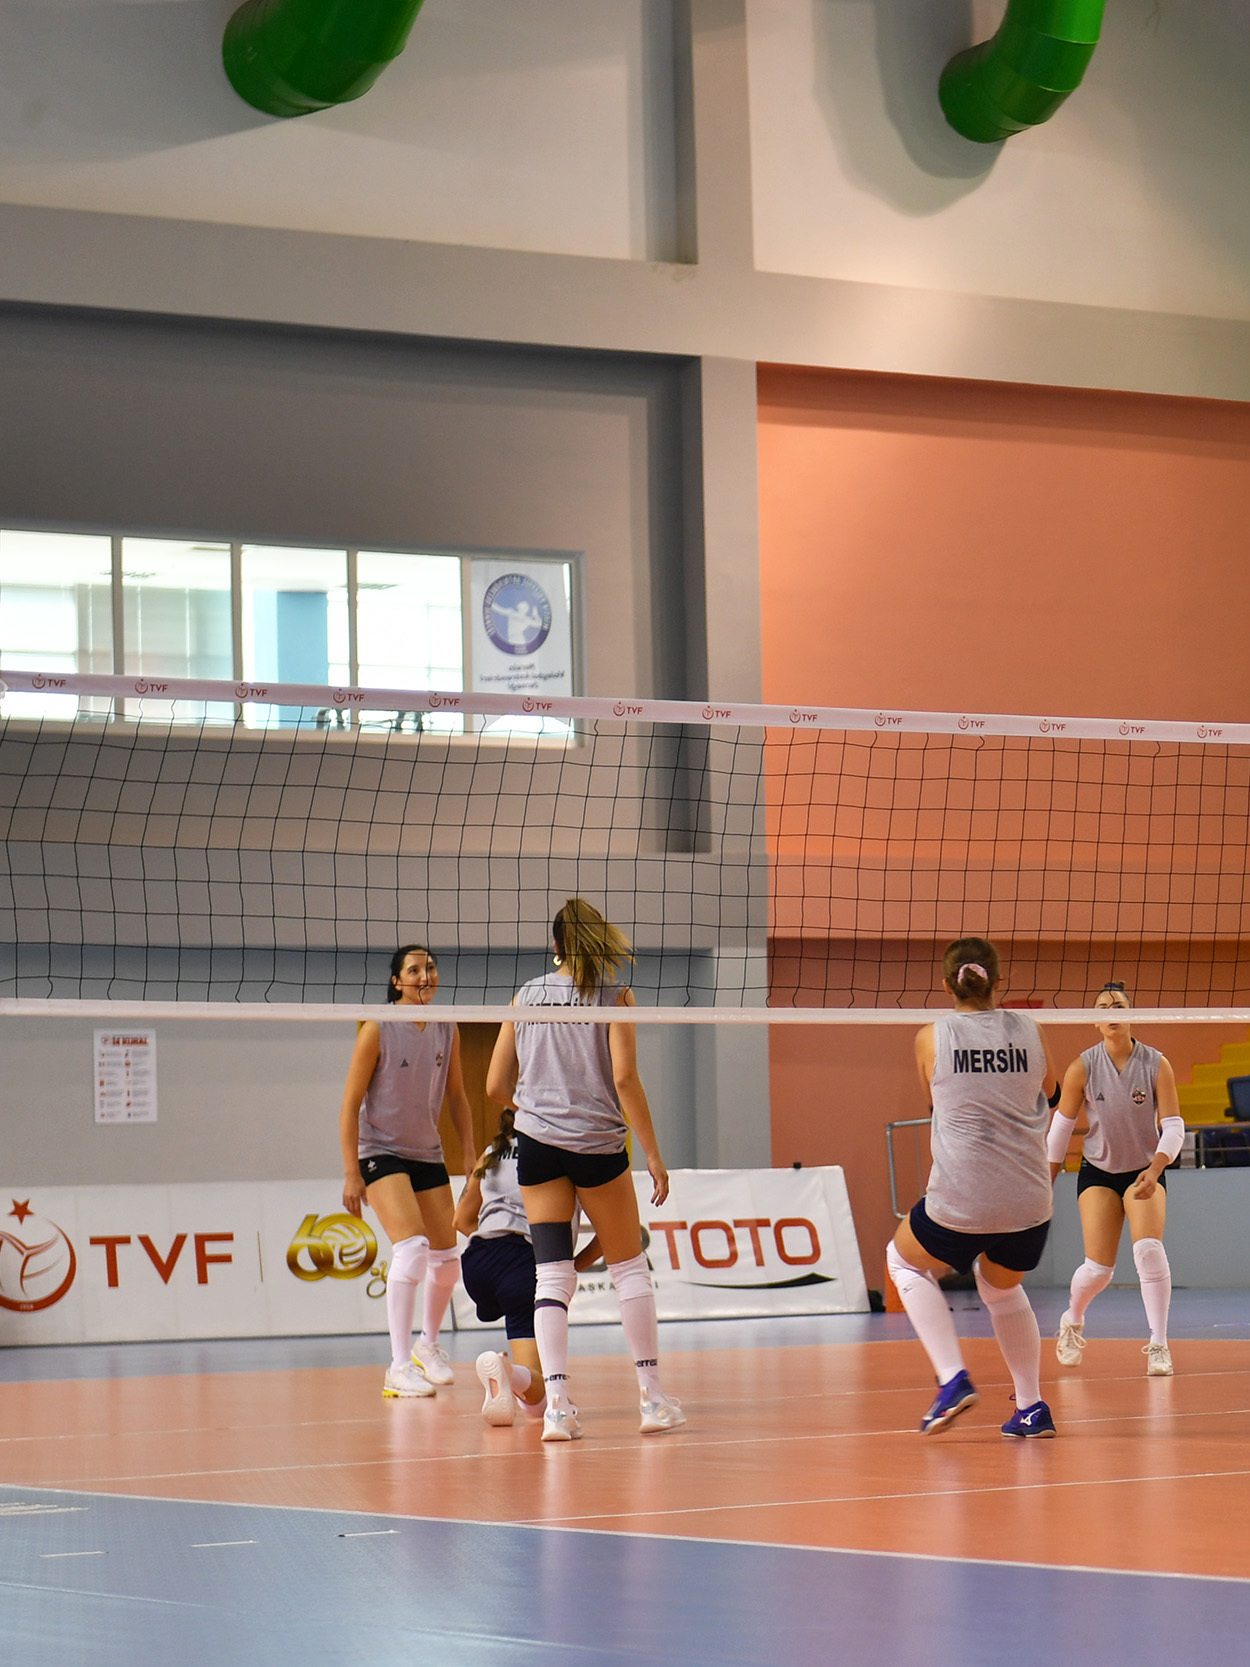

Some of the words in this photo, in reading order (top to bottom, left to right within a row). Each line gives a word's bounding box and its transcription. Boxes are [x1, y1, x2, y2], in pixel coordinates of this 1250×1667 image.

[48, 679, 66, 687] TVF
[150, 684, 168, 692] TVF
[250, 689, 268, 697] TVF
[347, 693, 365, 702] TVF
[443, 698, 460, 706] TVF
[535, 702, 552, 710] TVF
[626, 706, 643, 714] TVF
[715, 710, 731, 718] TVF
[802, 714, 818, 722] TVF
[887, 717, 902, 725] TVF
[970, 720, 985, 728] TVF
[1051, 723, 1066, 731] TVF
[1131, 726, 1145, 734] TVF
[1208, 729, 1223, 737] TVF
[954, 1043, 1028, 1073] MERSİN
[89, 1232, 234, 1288] TVF
